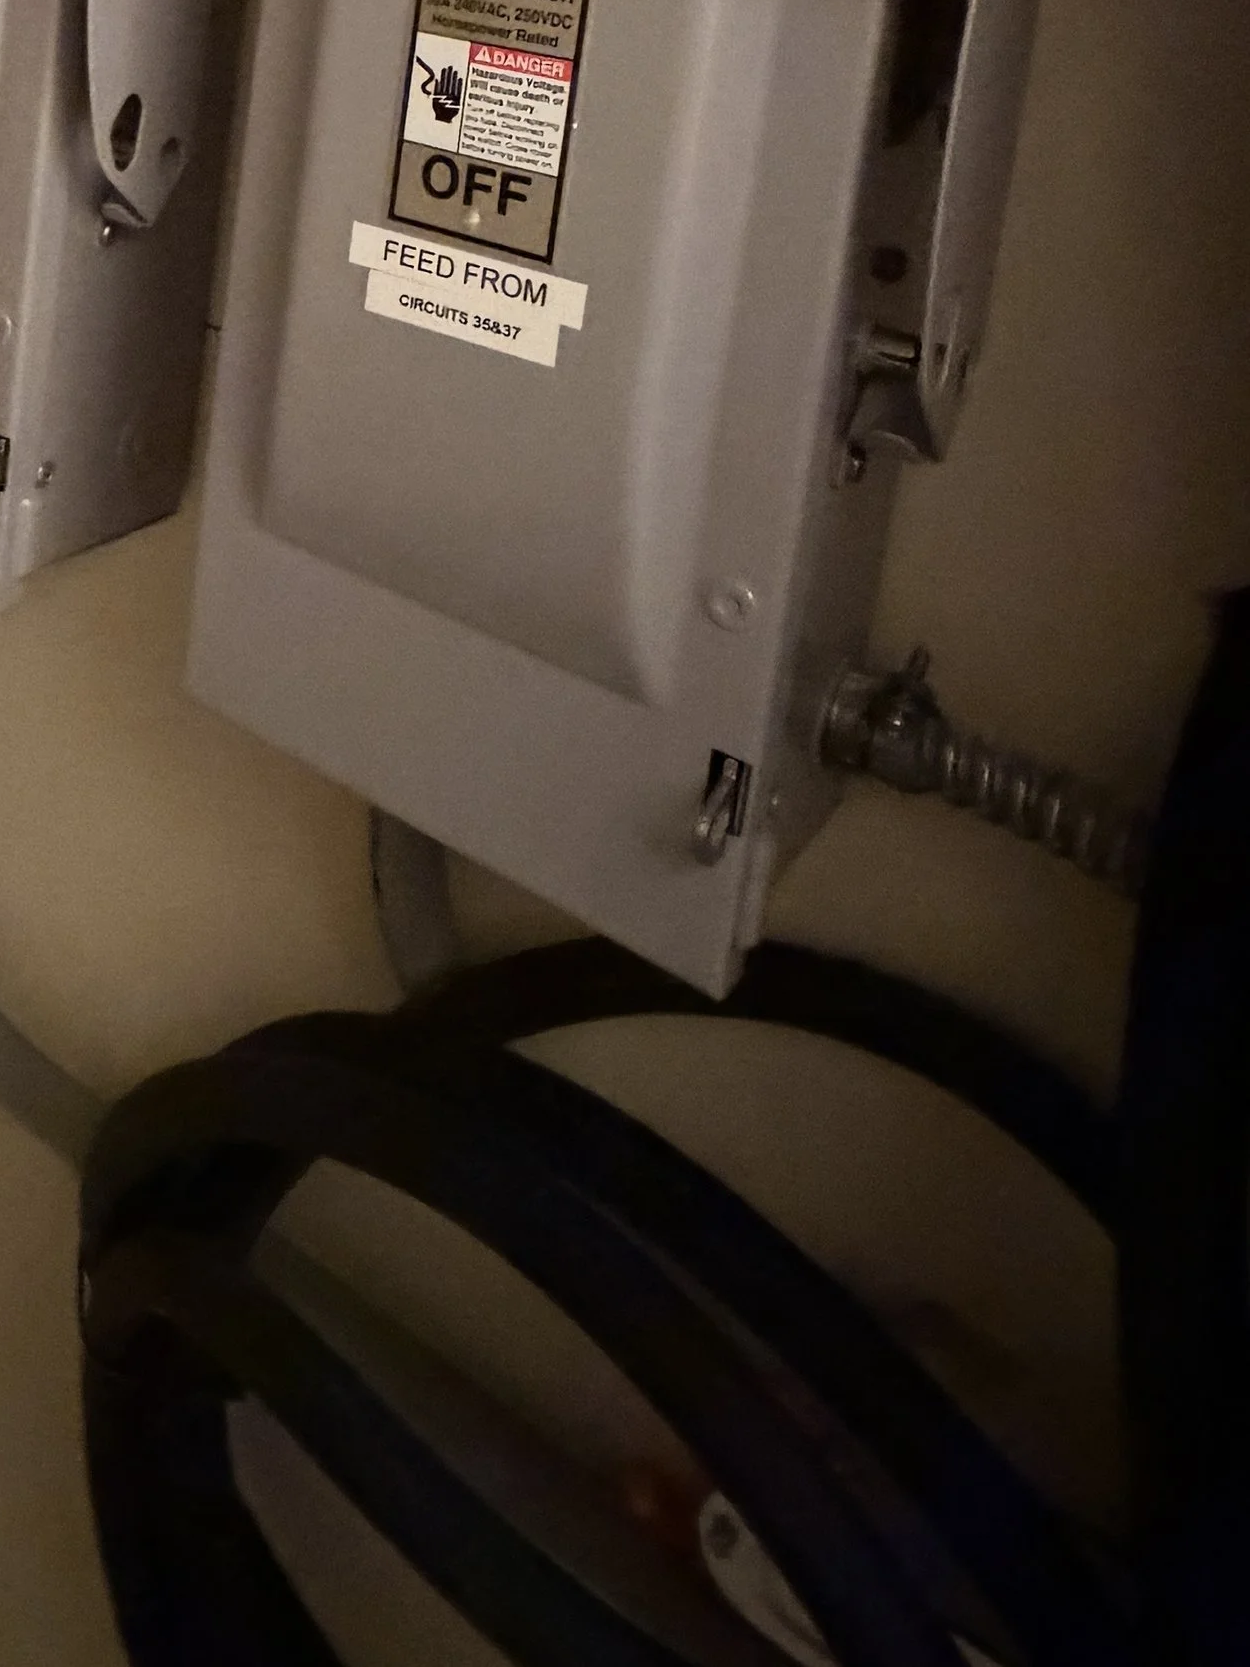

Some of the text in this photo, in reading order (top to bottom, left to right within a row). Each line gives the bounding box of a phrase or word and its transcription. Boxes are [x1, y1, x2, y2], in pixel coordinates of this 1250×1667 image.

[514, 7, 574, 30] 250VDC
[493, 50, 565, 78] DANGER
[422, 154, 532, 217] OFF
[383, 239, 548, 307] FEED FROM
[399, 294, 523, 340] CIRCUITS 35&37
